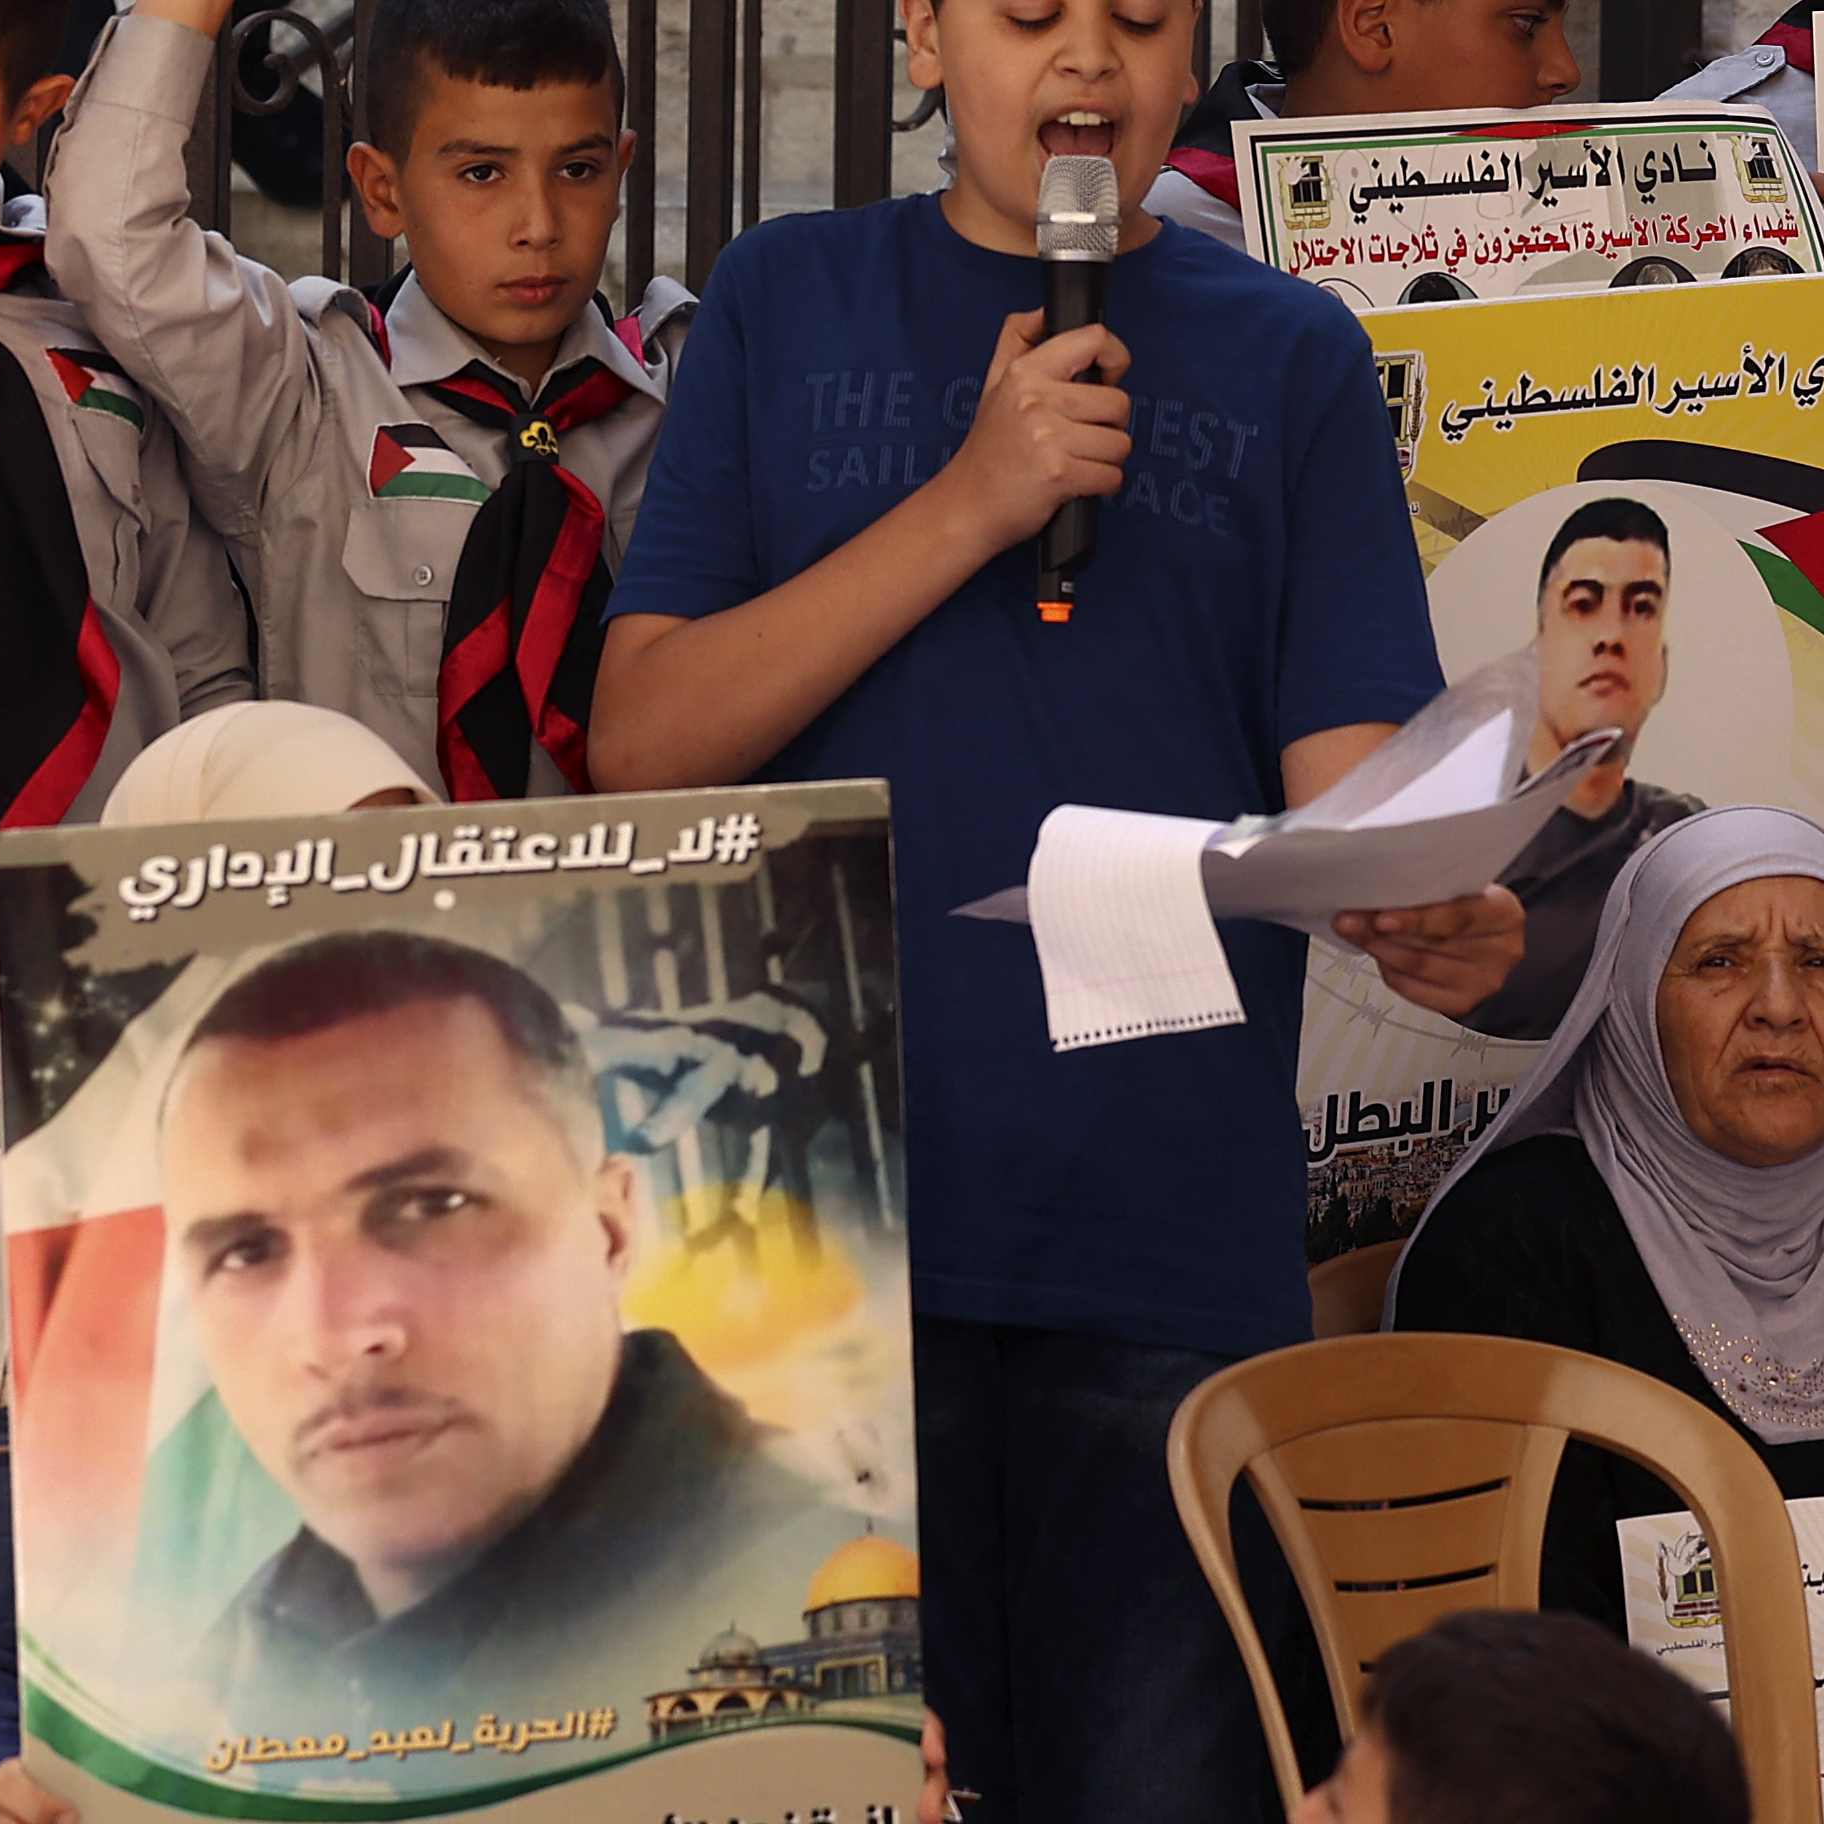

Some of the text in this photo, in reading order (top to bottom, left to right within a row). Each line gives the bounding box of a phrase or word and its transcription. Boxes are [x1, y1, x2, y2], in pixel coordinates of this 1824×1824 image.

[1350, 140, 1717, 223] نادي الأسير الفلسطيني
[1289, 209, 1799, 275] شهداء الحركة الأسيرة المحتجزون في ثلاجات الاحتلال
[805, 370, 914, 433] THE
[1441, 369, 1655, 441] الفلسطيني
[1656, 347, 1785, 417] الأسير
[1305, 1079, 1454, 1165] البطل
